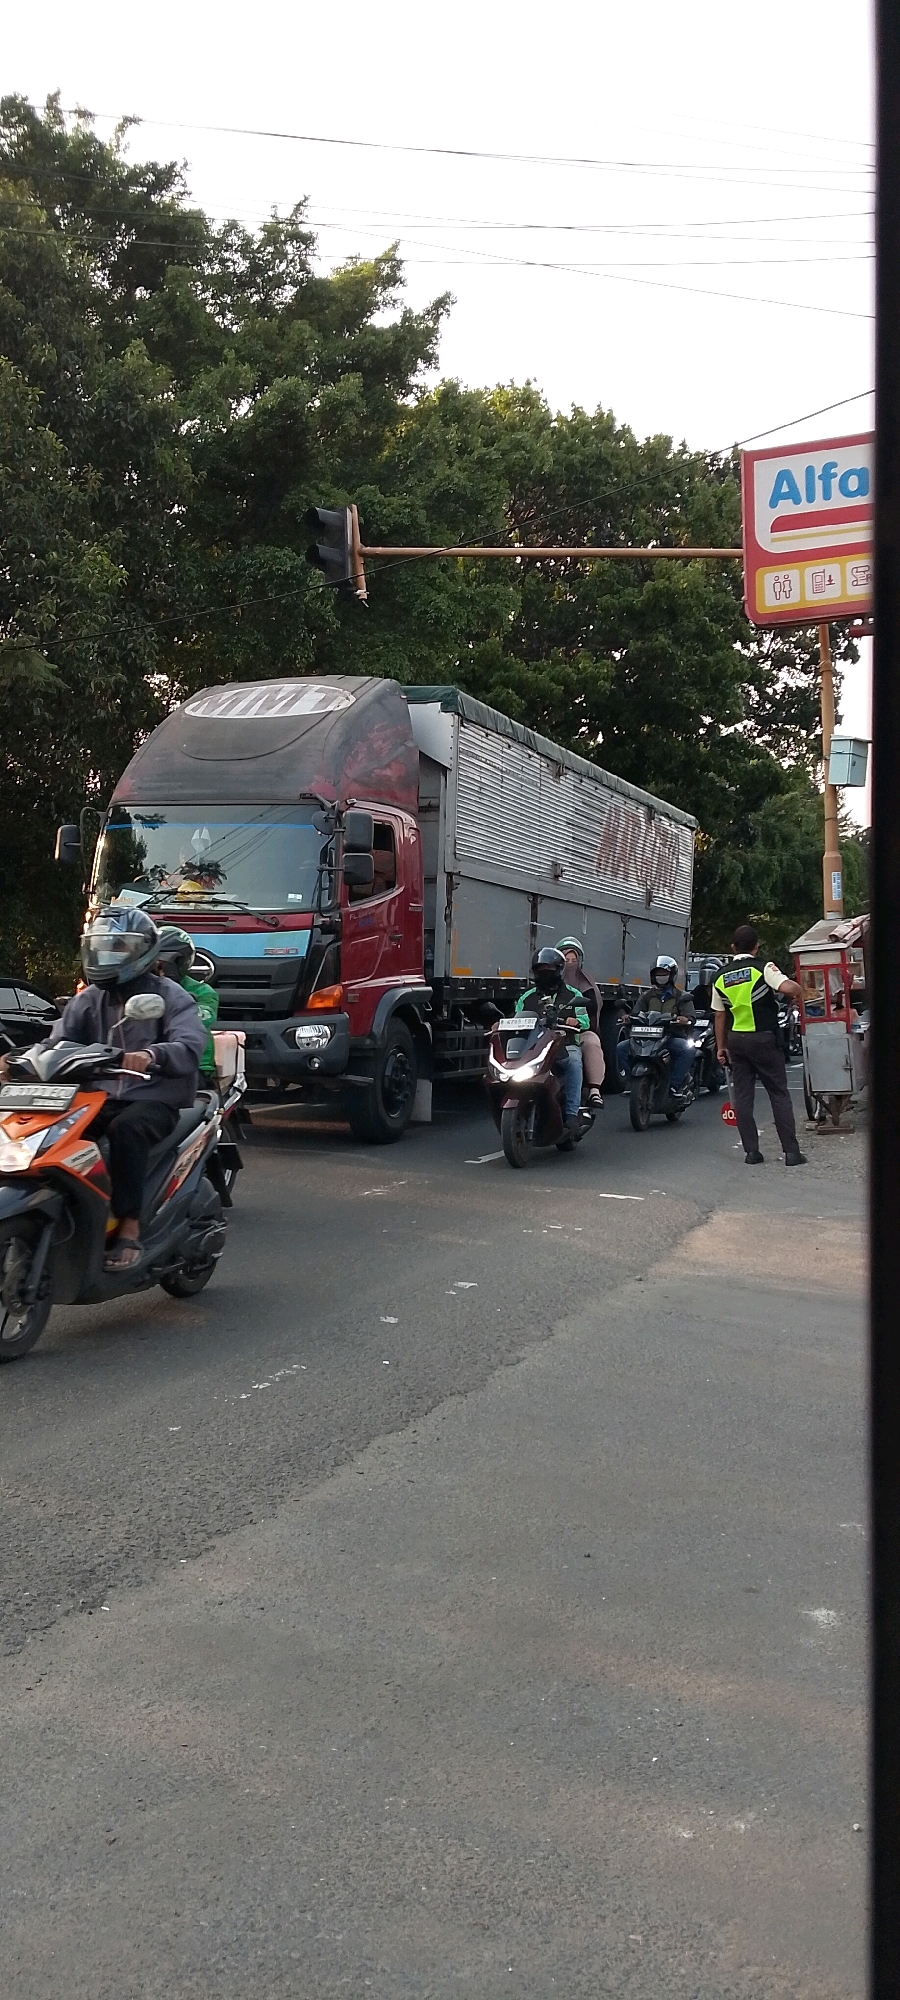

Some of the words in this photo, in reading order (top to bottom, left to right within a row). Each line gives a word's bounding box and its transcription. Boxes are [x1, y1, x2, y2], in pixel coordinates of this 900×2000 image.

[768, 461, 870, 510] Alfa
[192, 685, 338, 716] MMT
[723, 969, 751, 984] SIGAP
